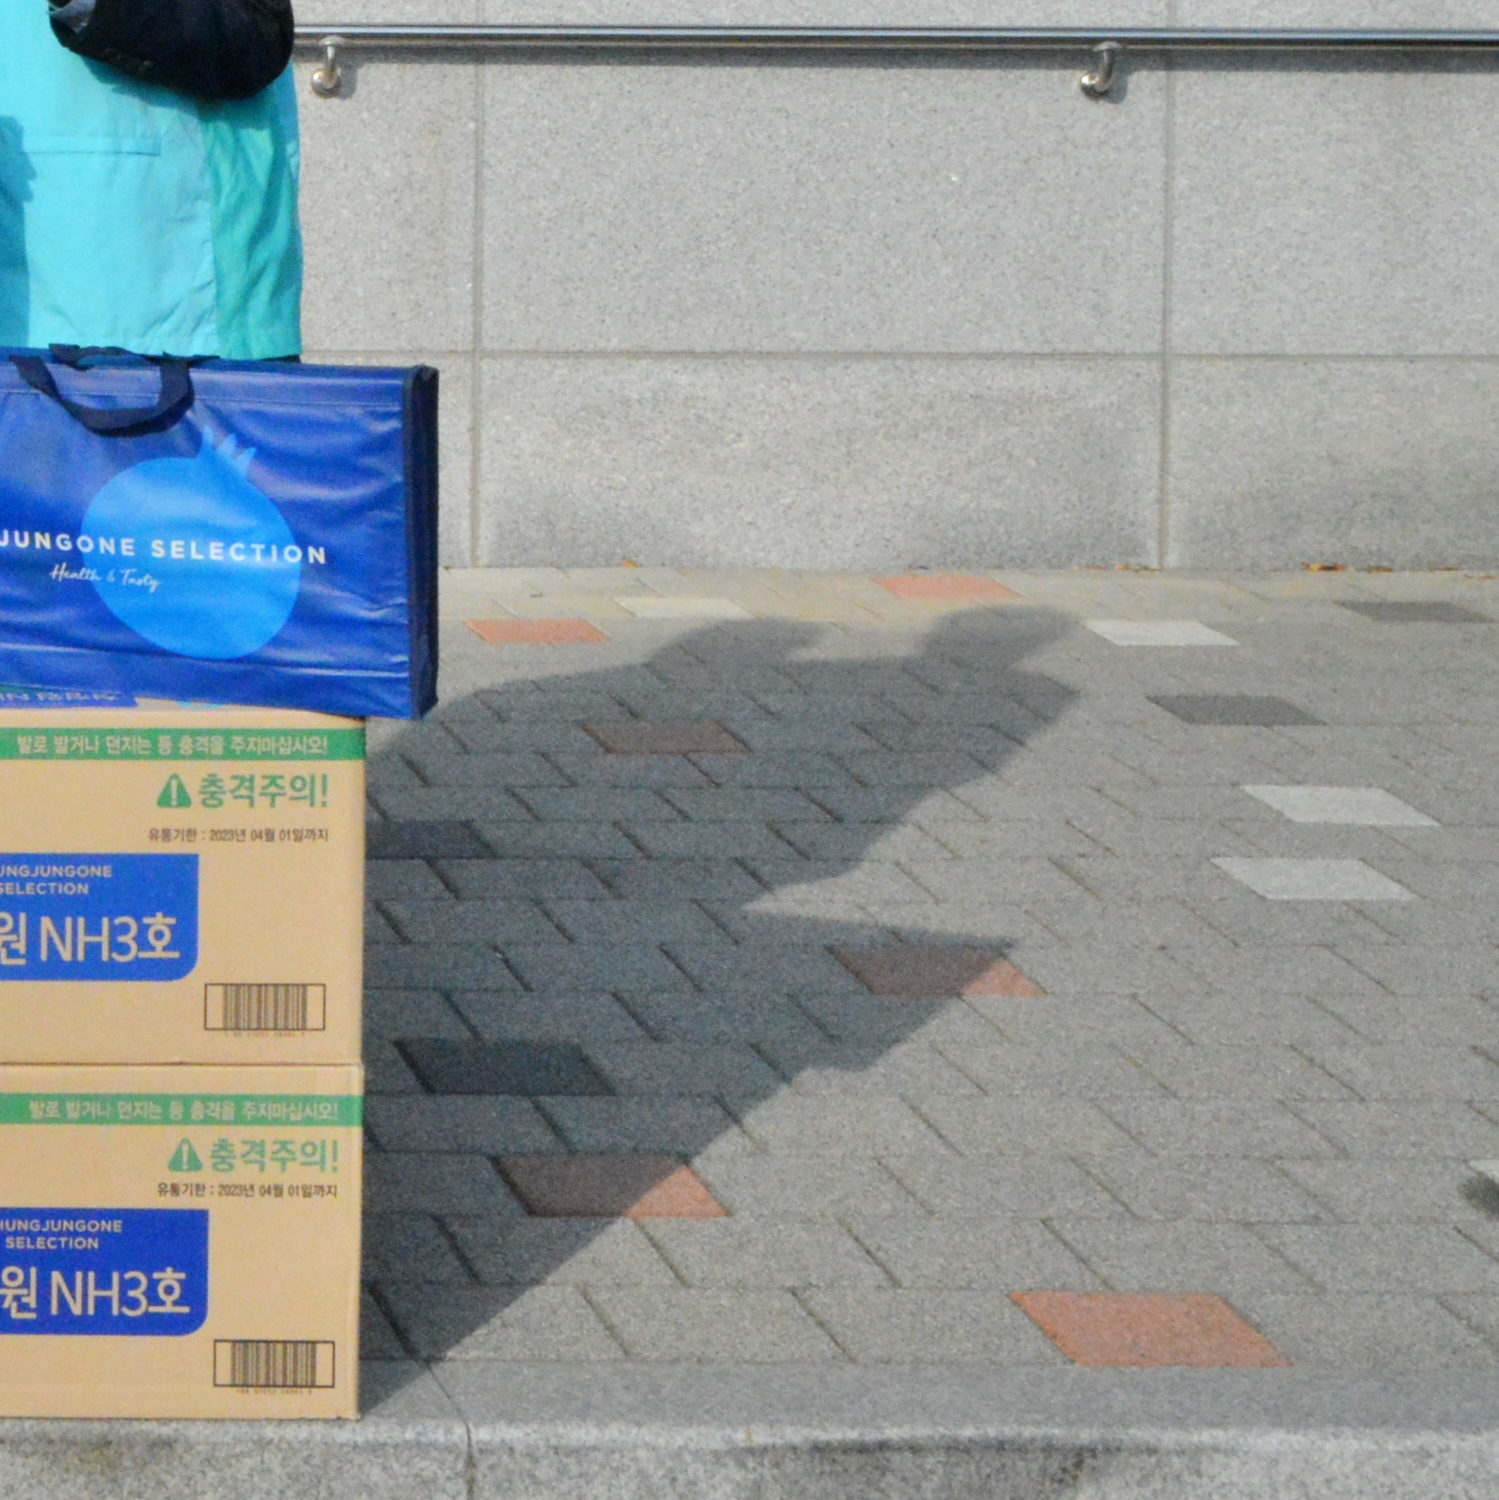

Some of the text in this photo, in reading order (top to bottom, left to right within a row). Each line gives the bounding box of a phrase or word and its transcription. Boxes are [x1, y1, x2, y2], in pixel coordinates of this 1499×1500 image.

[151, 540, 327, 566] SELECTION
[198, 774, 328, 808] 충격주의!
[40, 908, 180, 963] NH3호
[210, 1138, 339, 1172] 충격주의!
[5, 1236, 99, 1249] SELECTION
[51, 1264, 190, 1316] NH3호
